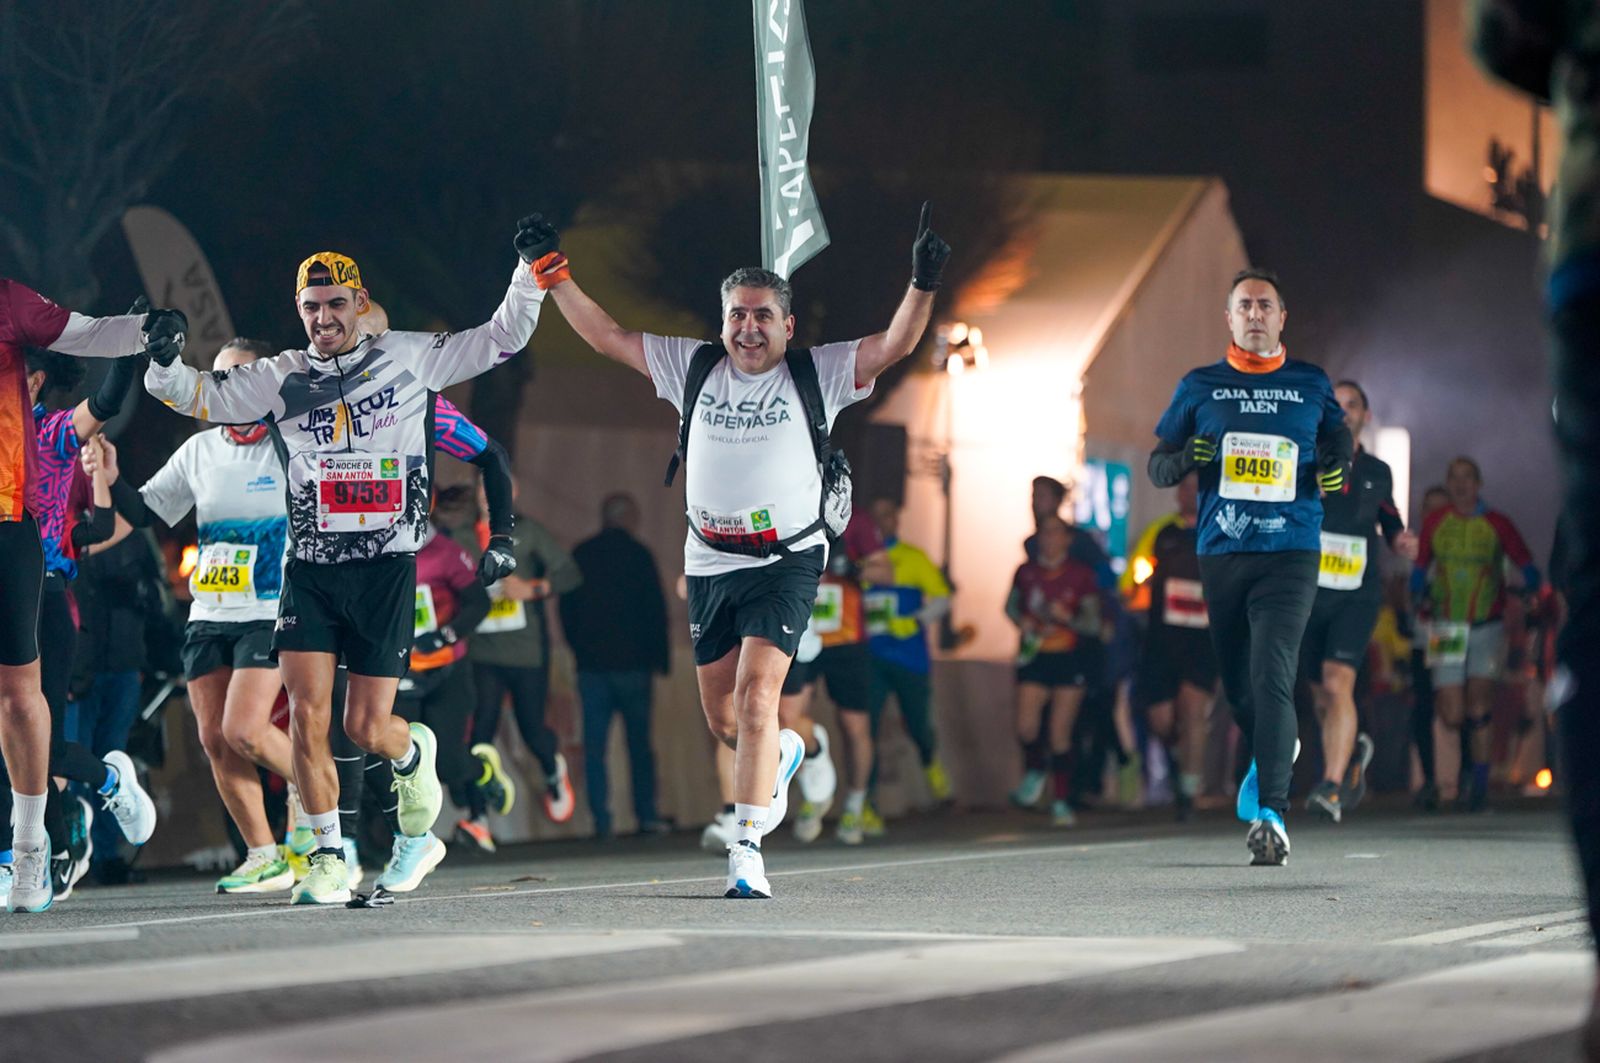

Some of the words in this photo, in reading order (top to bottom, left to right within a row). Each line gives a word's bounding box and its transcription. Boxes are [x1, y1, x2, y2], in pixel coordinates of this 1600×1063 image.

[699, 392, 790, 413] DACIA
[1211, 388, 1250, 400] CAJA
[1252, 388, 1304, 404] RURAL
[1239, 400, 1278, 414] JAÉN
[1231, 448, 1245, 457] SAN
[335, 462, 361, 470] NOCHE
[362, 462, 373, 470] DE
[1234, 457, 1283, 479] 9499
[326, 471, 343, 481] SAN
[344, 469, 374, 480] ANTÓN
[334, 481, 389, 505] 9753
